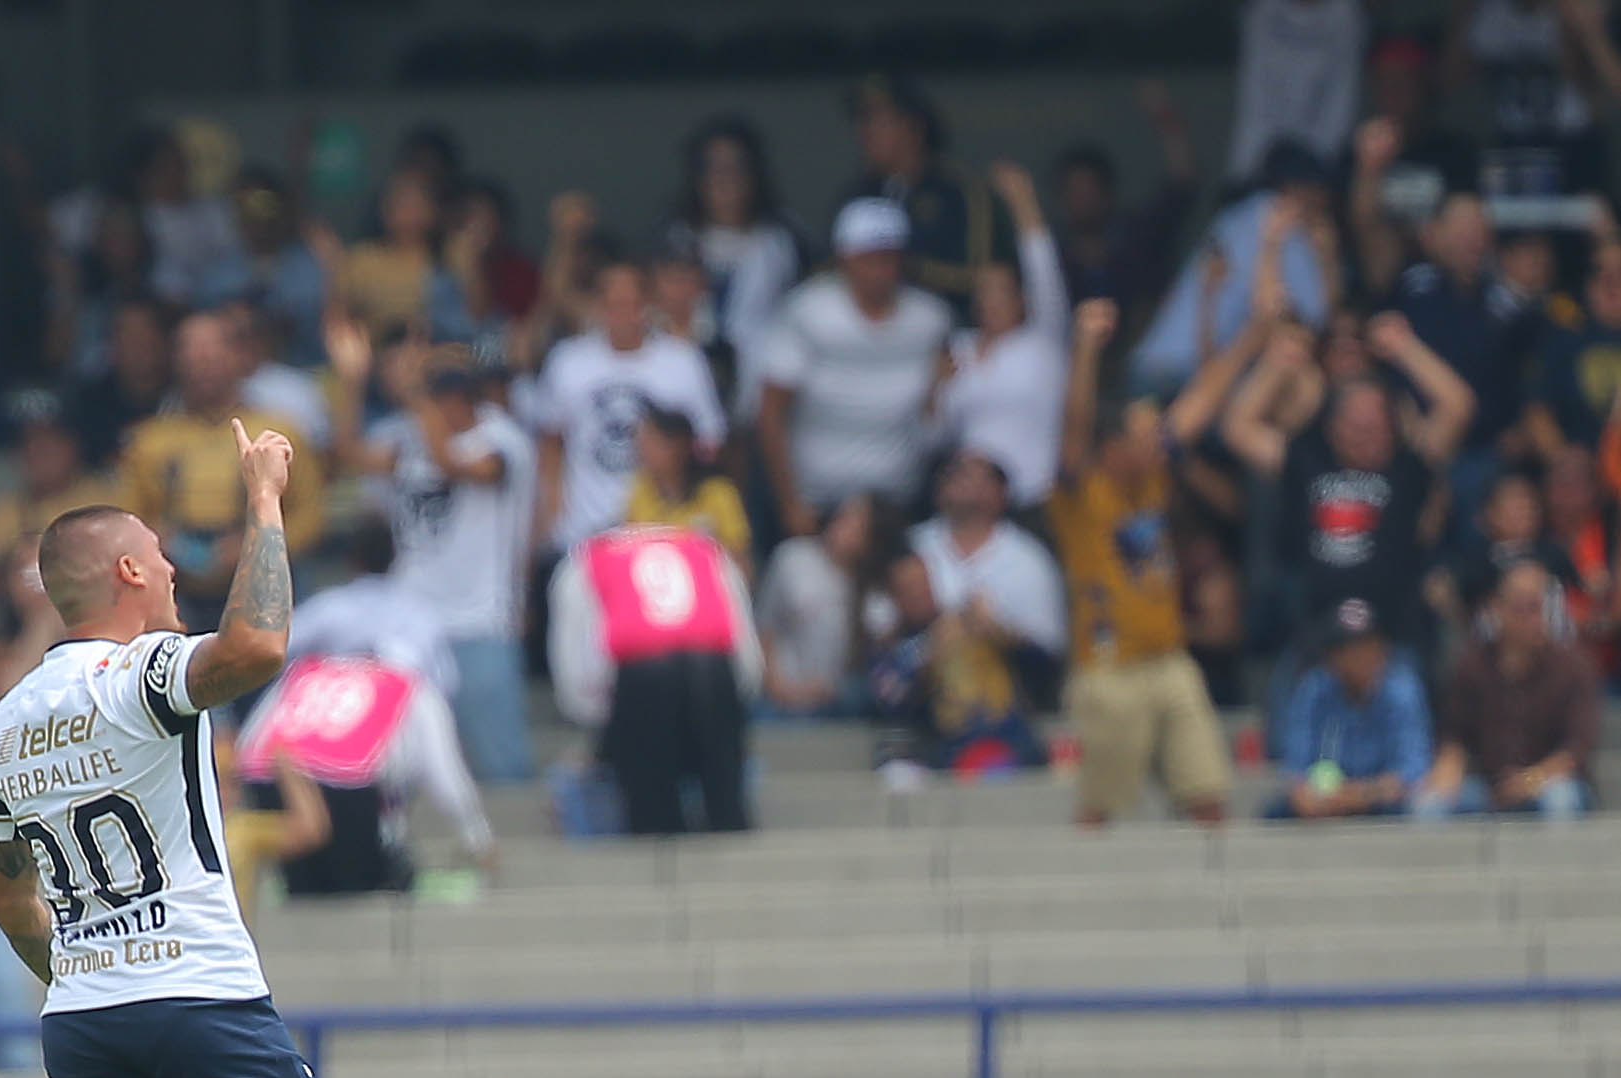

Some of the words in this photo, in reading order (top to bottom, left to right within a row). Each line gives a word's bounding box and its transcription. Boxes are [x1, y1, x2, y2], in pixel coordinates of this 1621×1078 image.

[18, 702, 98, 760] telcel
[56, 948, 116, 977] orona
[123, 938, 183, 965] Cero
